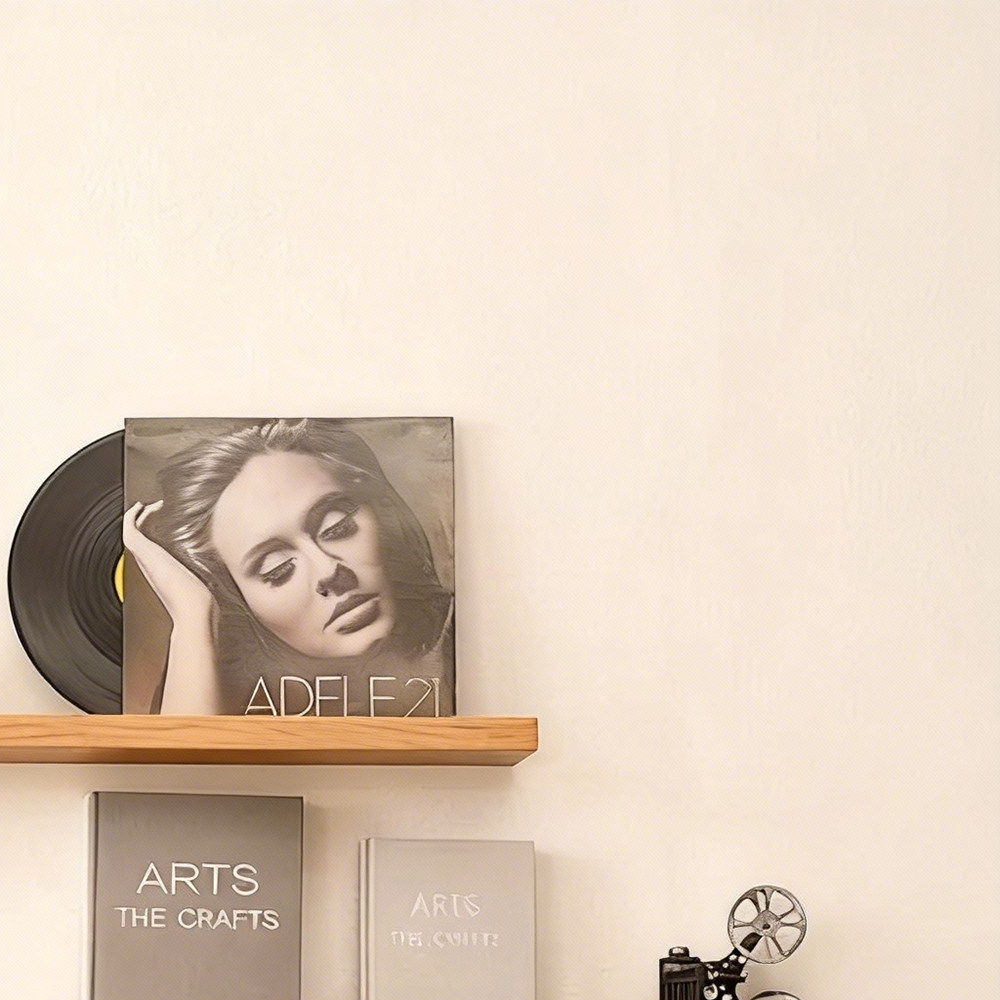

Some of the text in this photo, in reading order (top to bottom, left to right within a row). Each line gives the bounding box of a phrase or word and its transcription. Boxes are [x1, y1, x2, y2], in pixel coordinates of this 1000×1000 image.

[136, 862, 260, 896] ARTS
[114, 907, 280, 930] THE CRAFTS
